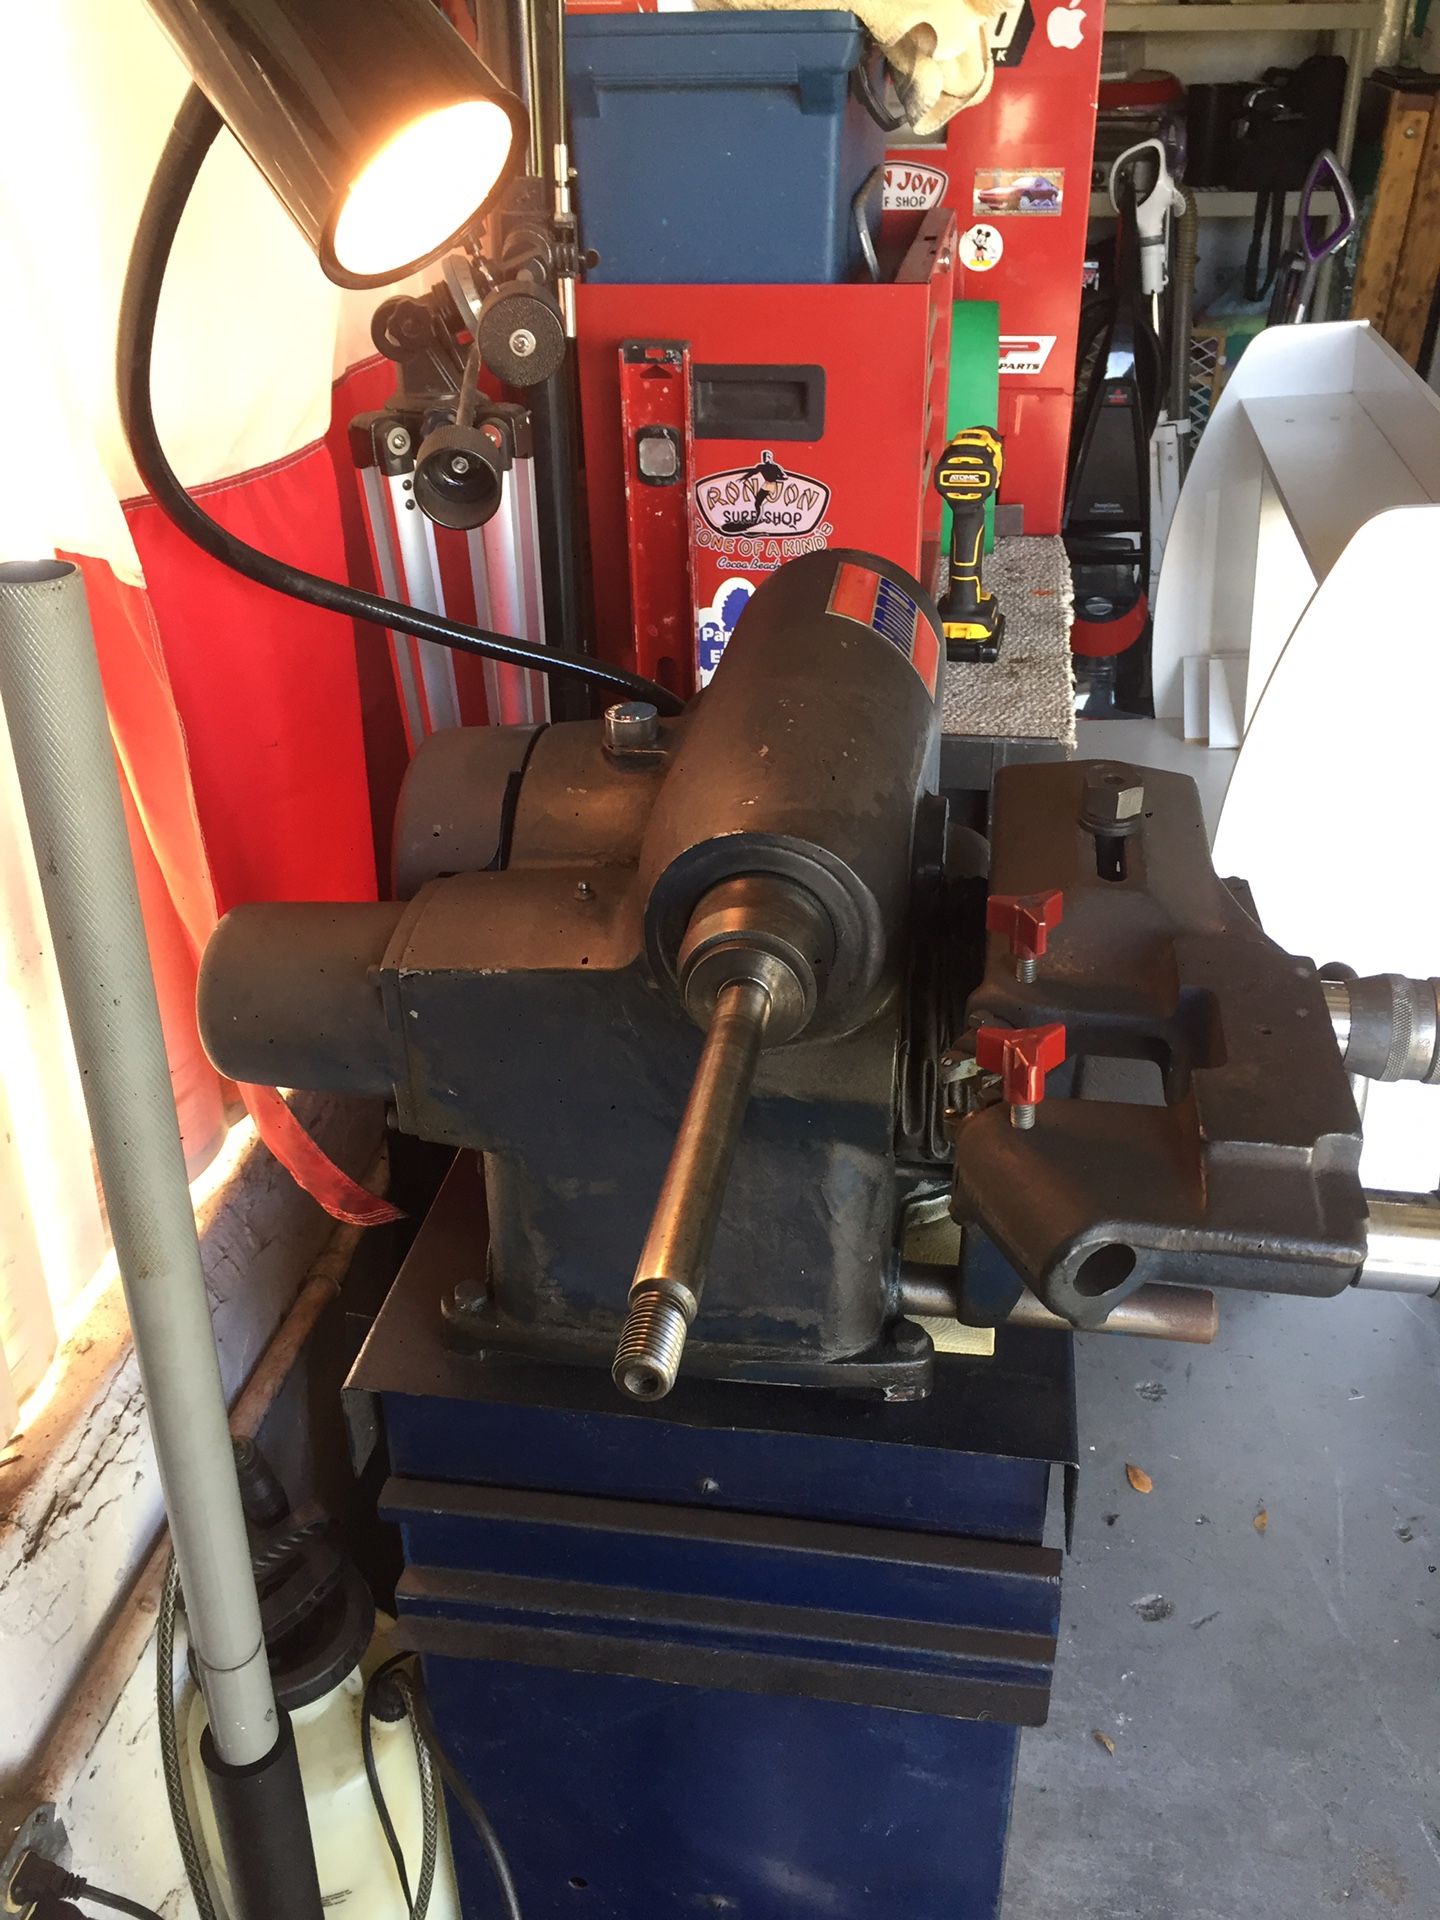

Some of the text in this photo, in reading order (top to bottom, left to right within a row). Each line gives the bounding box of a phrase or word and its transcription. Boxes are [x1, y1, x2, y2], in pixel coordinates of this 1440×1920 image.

[896, 171, 939, 195] JON
[895, 196, 926, 208] SHOP
[949, 474, 981, 483] ATOMIC
[707, 478, 819, 510] RON JON
[723, 511, 802, 525] SURF SHOP
[738, 539, 765, 556] OF
[766, 541, 781, 556] A
[718, 557, 748, 570] Cocoa
[702, 627, 735, 641] Par
